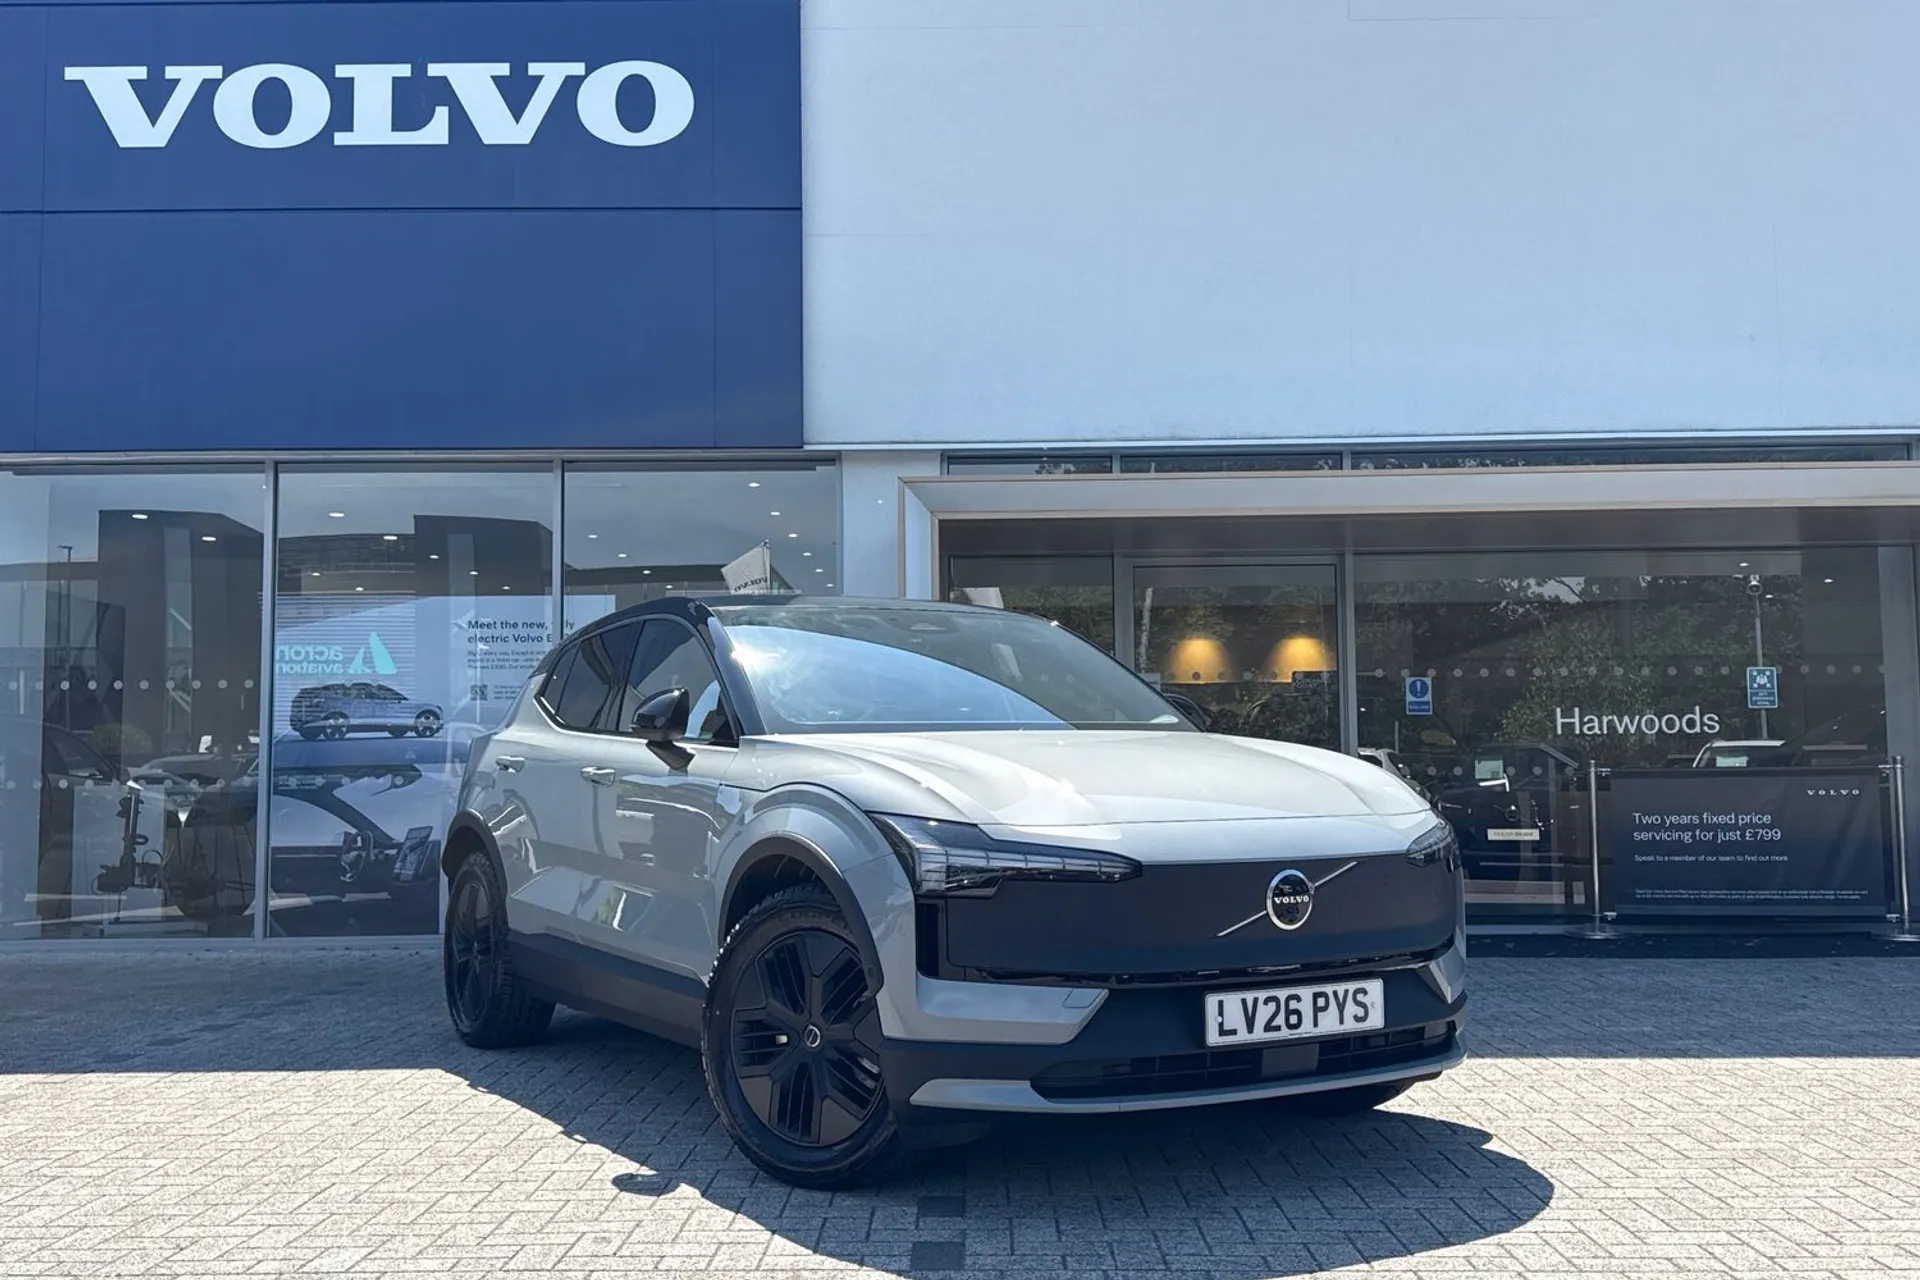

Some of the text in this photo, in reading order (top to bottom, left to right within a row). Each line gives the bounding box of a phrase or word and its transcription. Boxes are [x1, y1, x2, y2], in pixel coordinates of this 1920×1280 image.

[64, 60, 695, 149] VOLVO
[467, 620, 497, 630] Meet
[500, 620, 519, 630] the
[521, 621, 548, 631] new,
[467, 633, 508, 643] electric
[512, 634, 542, 643] Volvo
[1556, 705, 1720, 735] Harwoods
[1807, 788, 1860, 796] VOLVO
[1633, 811, 1772, 827] Two years fixed price
[1633, 828, 1781, 844] servicing for just £799
[1273, 894, 1310, 904] VOLVO
[1217, 987, 1370, 1038] LV26 PYS
